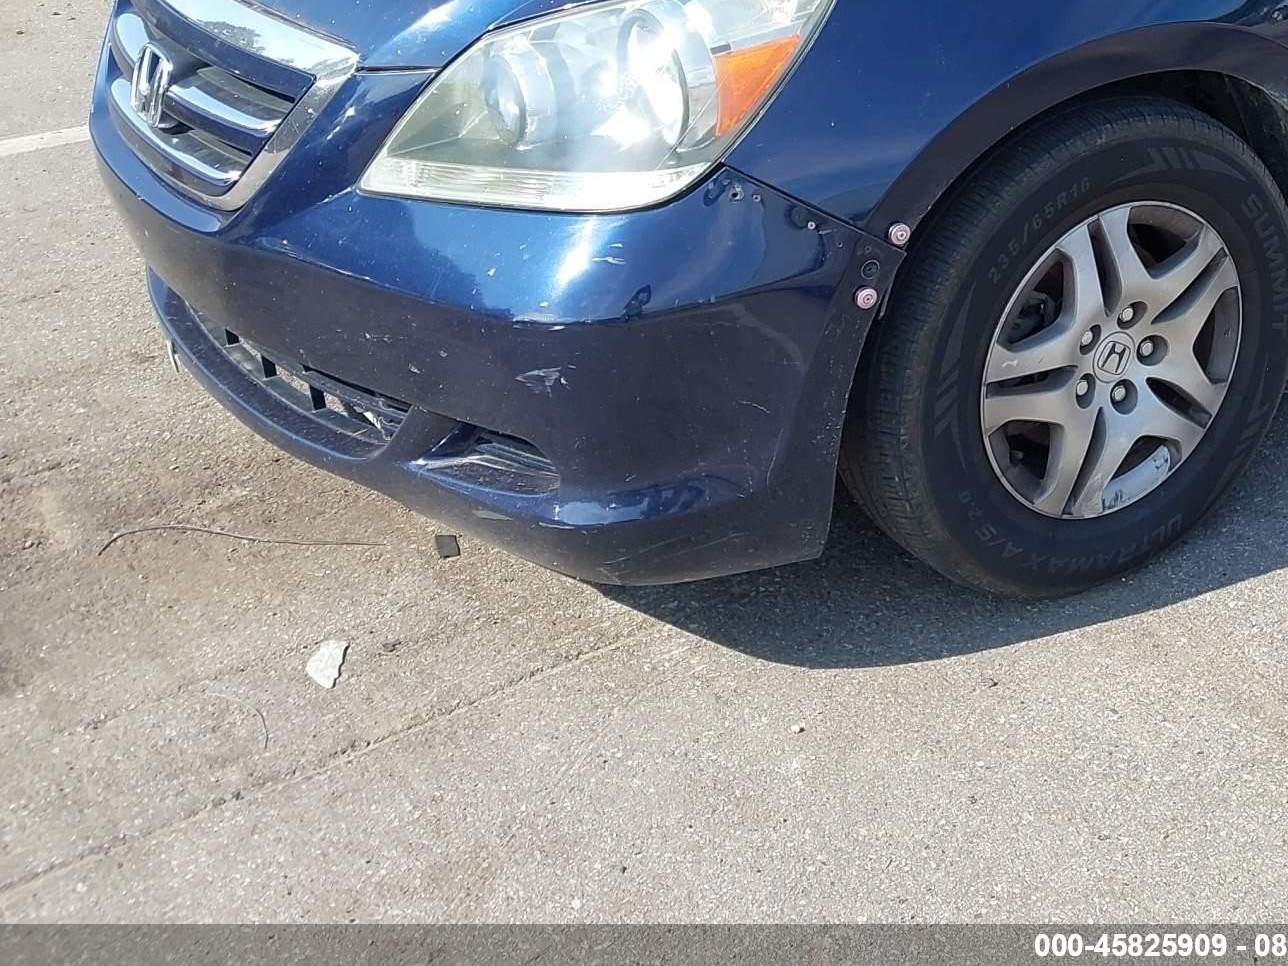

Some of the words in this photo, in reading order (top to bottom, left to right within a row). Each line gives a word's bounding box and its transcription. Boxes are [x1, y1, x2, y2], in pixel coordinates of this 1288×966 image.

[988, 176, 1092, 285] 235/65R16
[1241, 192, 1286, 332] SUMMIT
[973, 522, 1024, 559] A/S
[1022, 514, 1184, 575] ULTRAMAX
